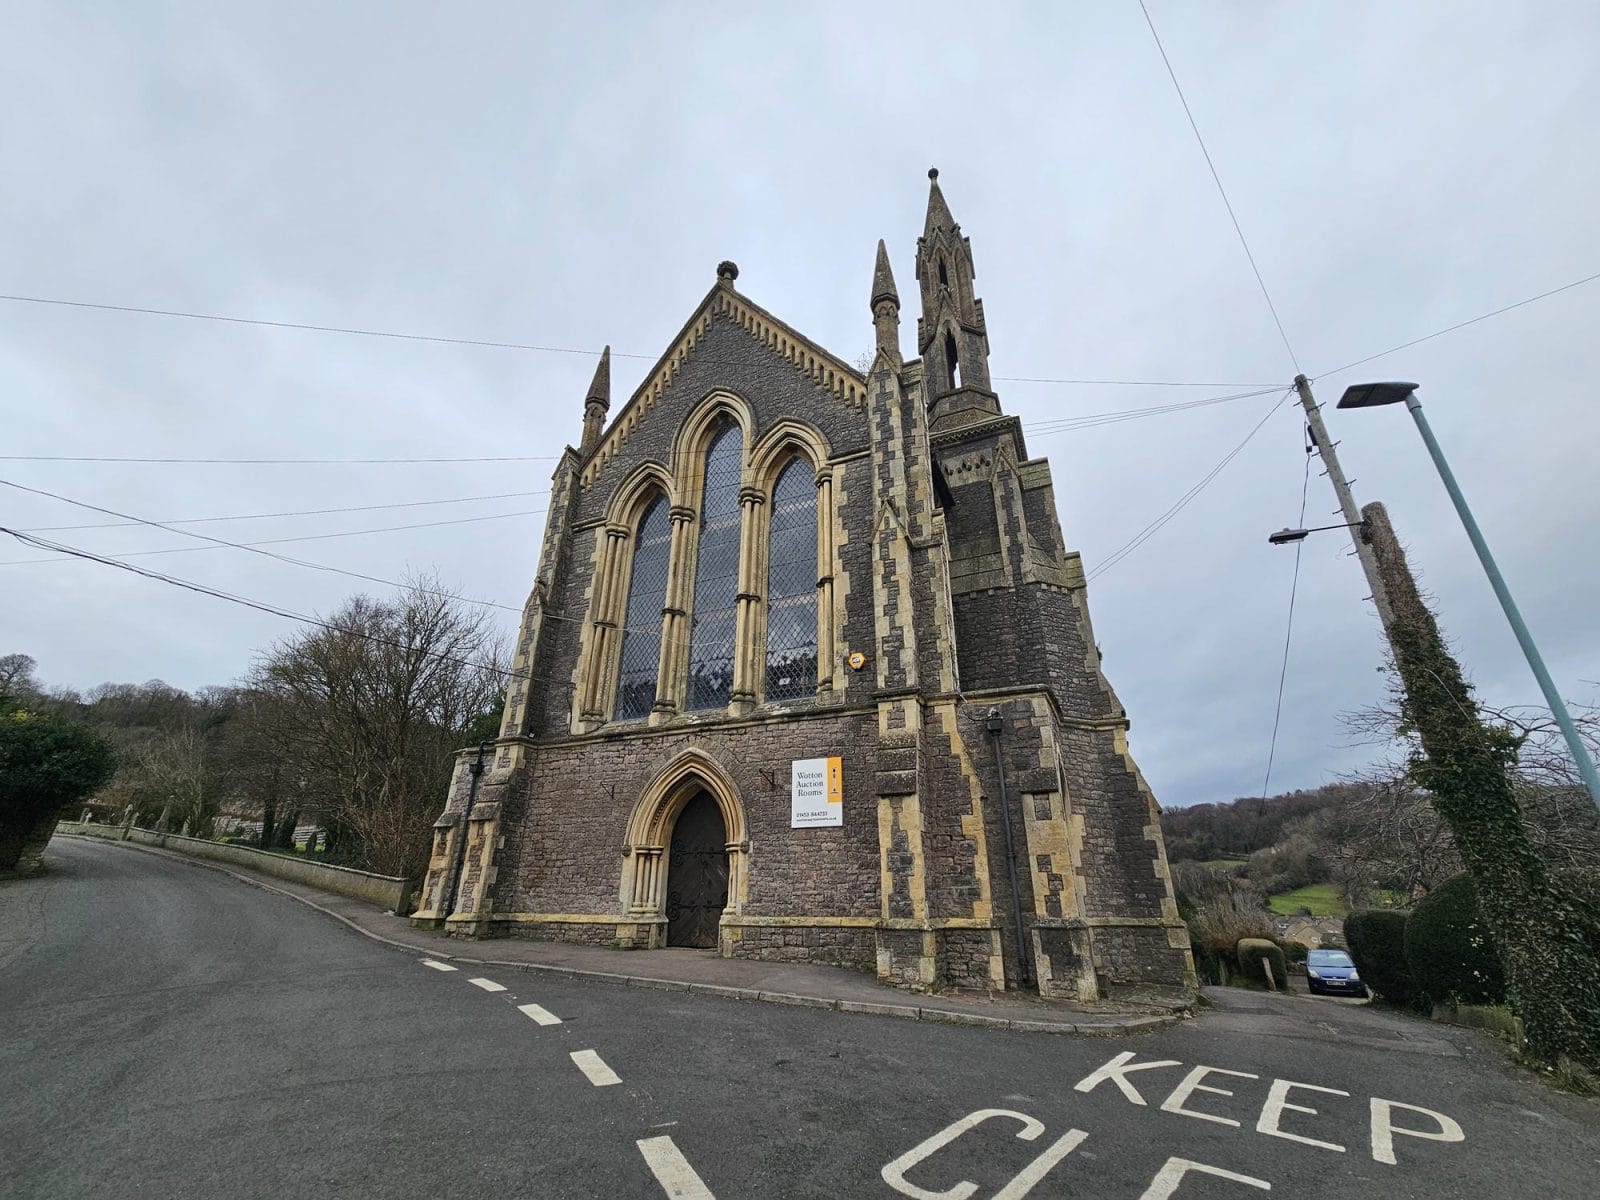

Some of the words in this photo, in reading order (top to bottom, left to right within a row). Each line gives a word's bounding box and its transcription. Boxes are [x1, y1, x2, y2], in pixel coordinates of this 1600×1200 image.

[797, 772, 823, 780] Wotton
[798, 789, 823, 797] Rooms
[1073, 1051, 1465, 1165] KEEP
